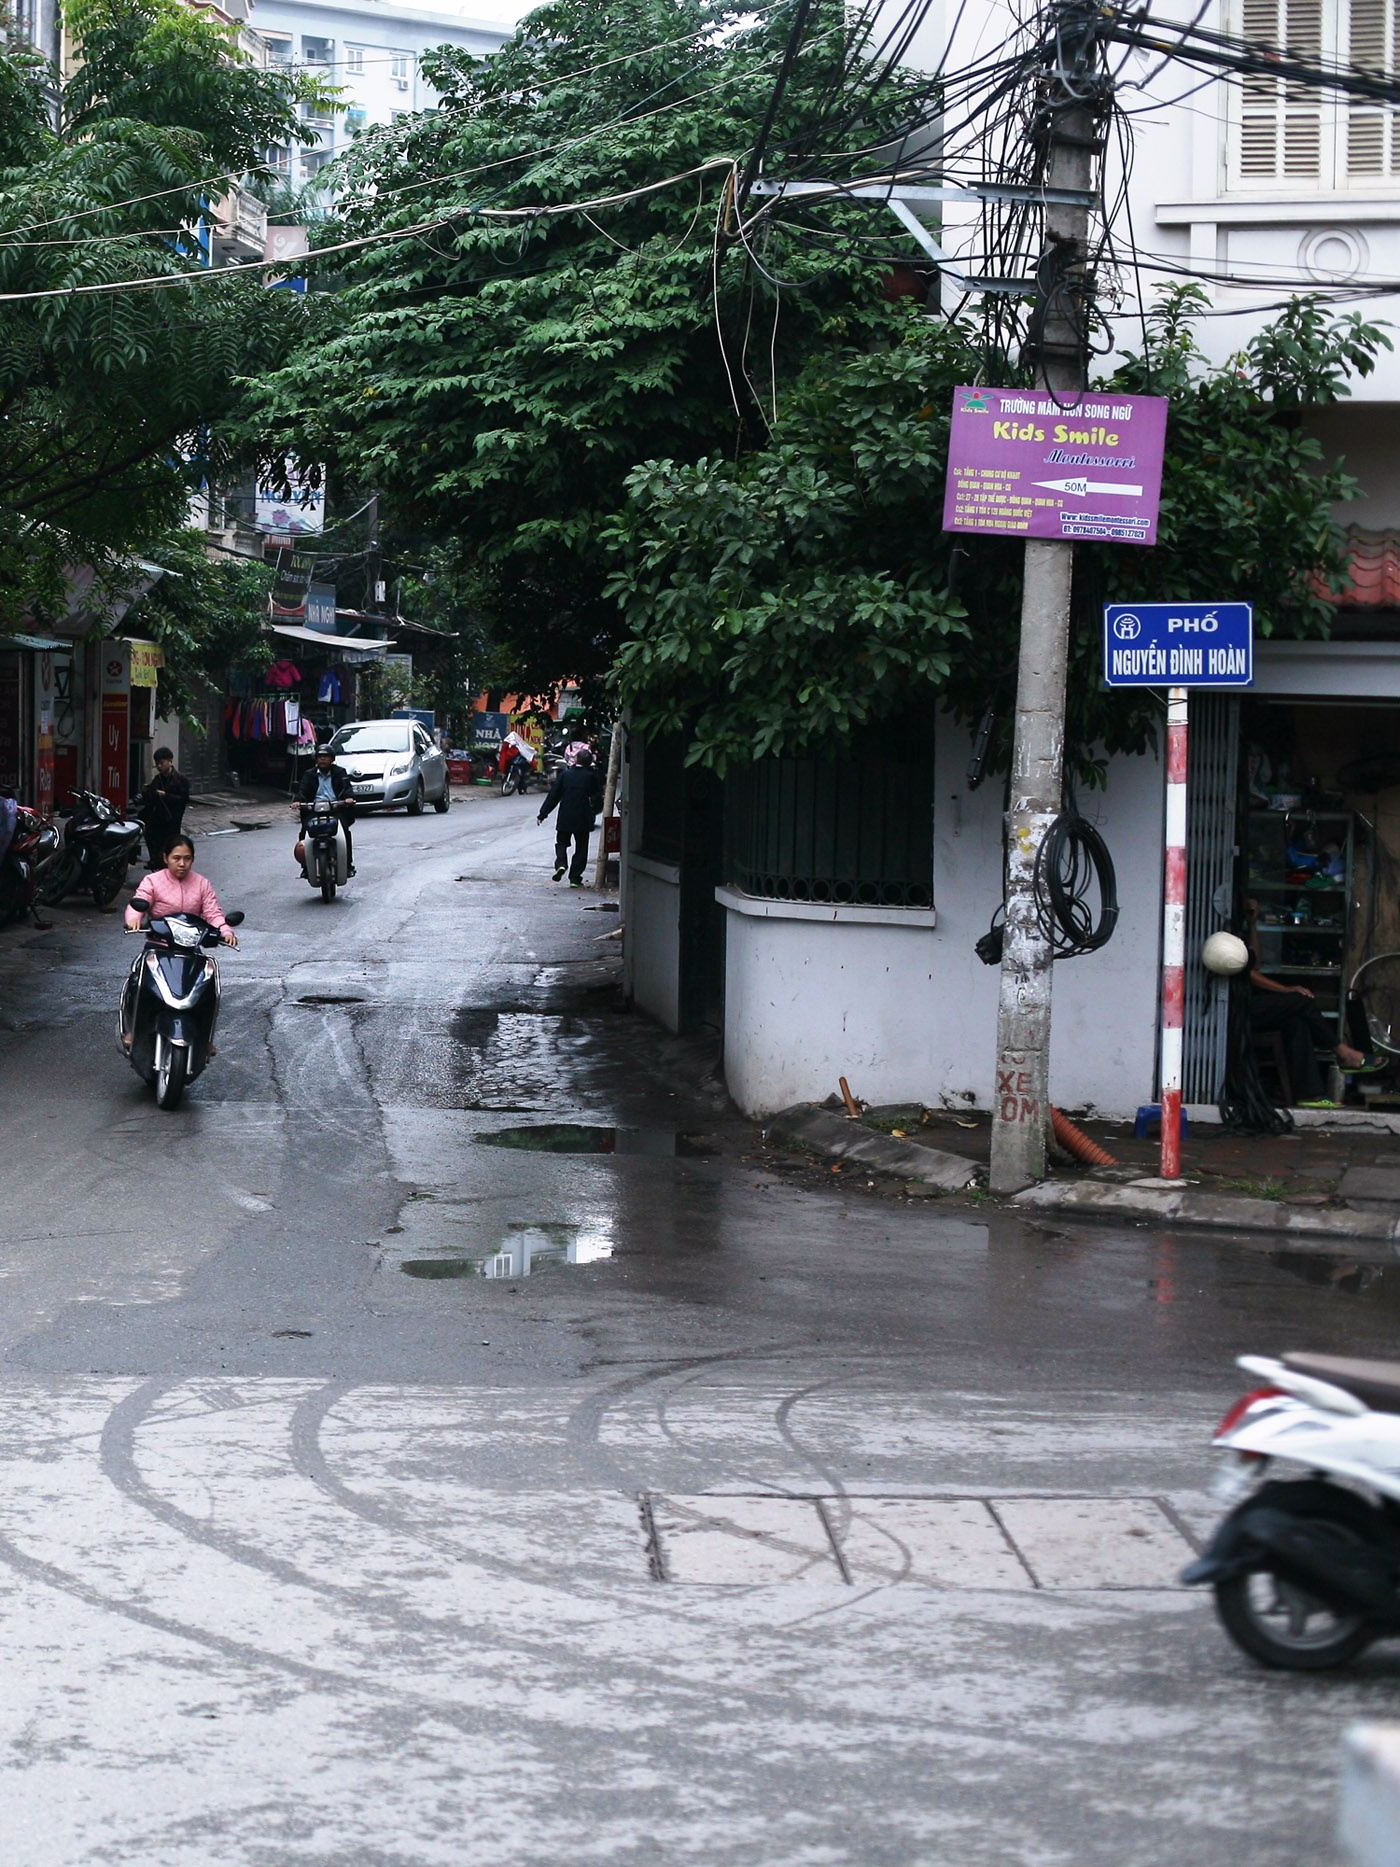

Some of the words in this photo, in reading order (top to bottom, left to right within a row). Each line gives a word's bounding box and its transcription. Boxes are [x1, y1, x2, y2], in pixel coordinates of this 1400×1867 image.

[1084, 404, 1110, 419] SONG
[993, 421, 1045, 443] Kids
[1053, 424, 1120, 447] Smile
[1064, 482, 1087, 493] 50M
[1167, 610, 1219, 634] PHỐ
[1112, 639, 1166, 676] NGUYỄN
[1169, 643, 1203, 676] ĐÌNH
[1208, 643, 1246, 675] HOÀN
[108, 724, 120, 752] Uy
[475, 728, 502, 739] NHÀ
[107, 765, 120, 789] Tín
[998, 1070, 1034, 1095] XE
